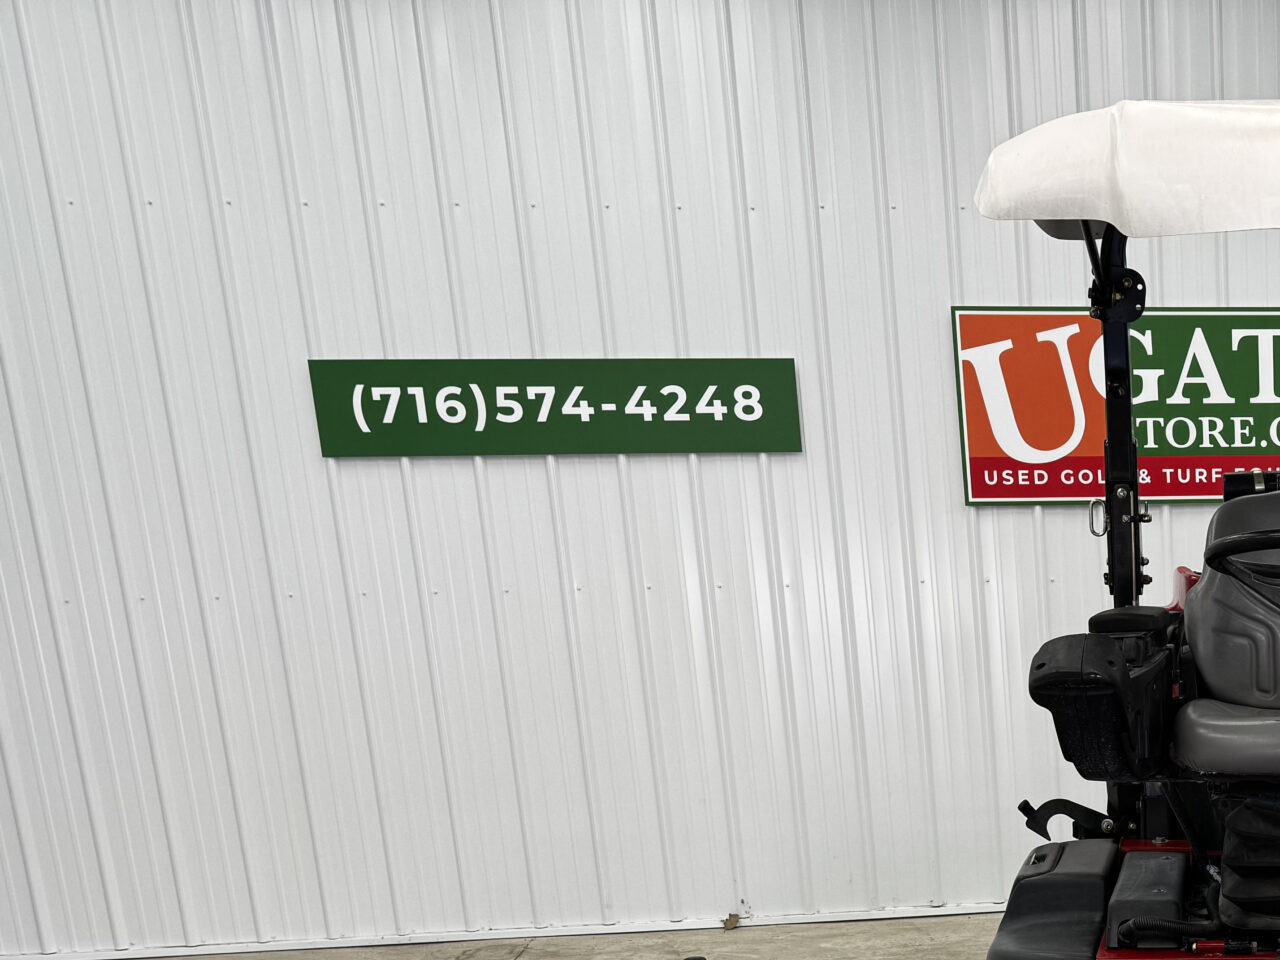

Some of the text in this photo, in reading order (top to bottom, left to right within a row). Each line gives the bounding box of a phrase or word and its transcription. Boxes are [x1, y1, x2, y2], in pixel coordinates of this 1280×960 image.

[352, 384, 763, 432] (716)574-4248
[984, 469, 1049, 485] USED
[1060, 469, 1106, 485] GOL
[1138, 468, 1152, 484] &
[1162, 468, 1223, 484] TURF
